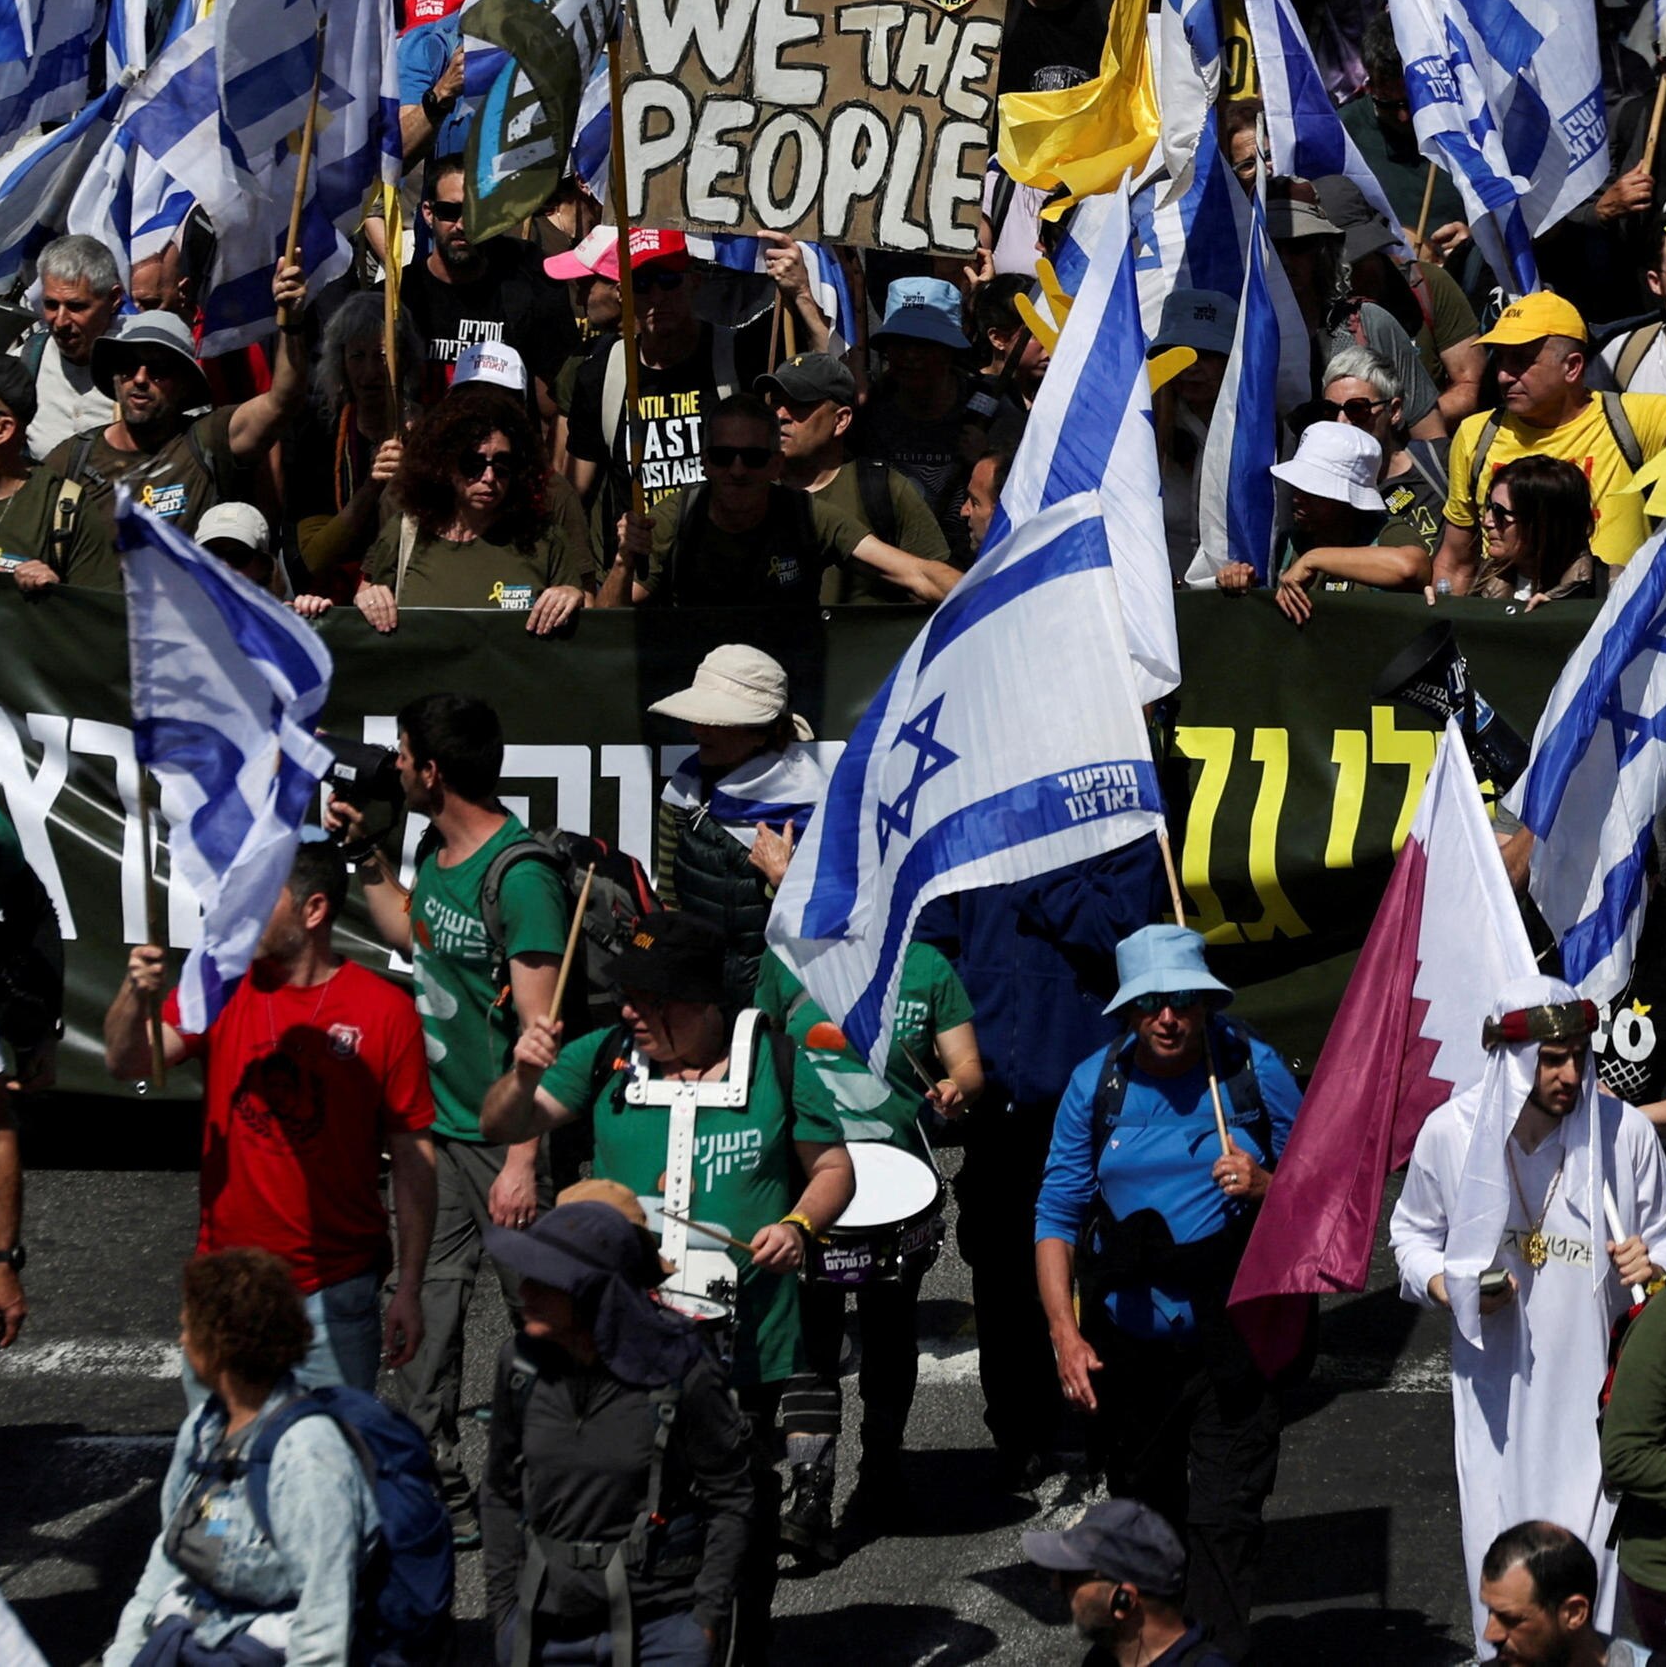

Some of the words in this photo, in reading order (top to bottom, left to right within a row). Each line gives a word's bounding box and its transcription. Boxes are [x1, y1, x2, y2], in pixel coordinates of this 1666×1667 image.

[415, 5, 444, 18] WAR
[838, 1, 1004, 119] THE
[622, 75, 991, 254] PEOPLE
[630, 241, 661, 256] WAR
[670, 390, 700, 416] THE
[1057, 763, 1137, 793] חופשי
[1064, 786, 1142, 821] בארצנו
